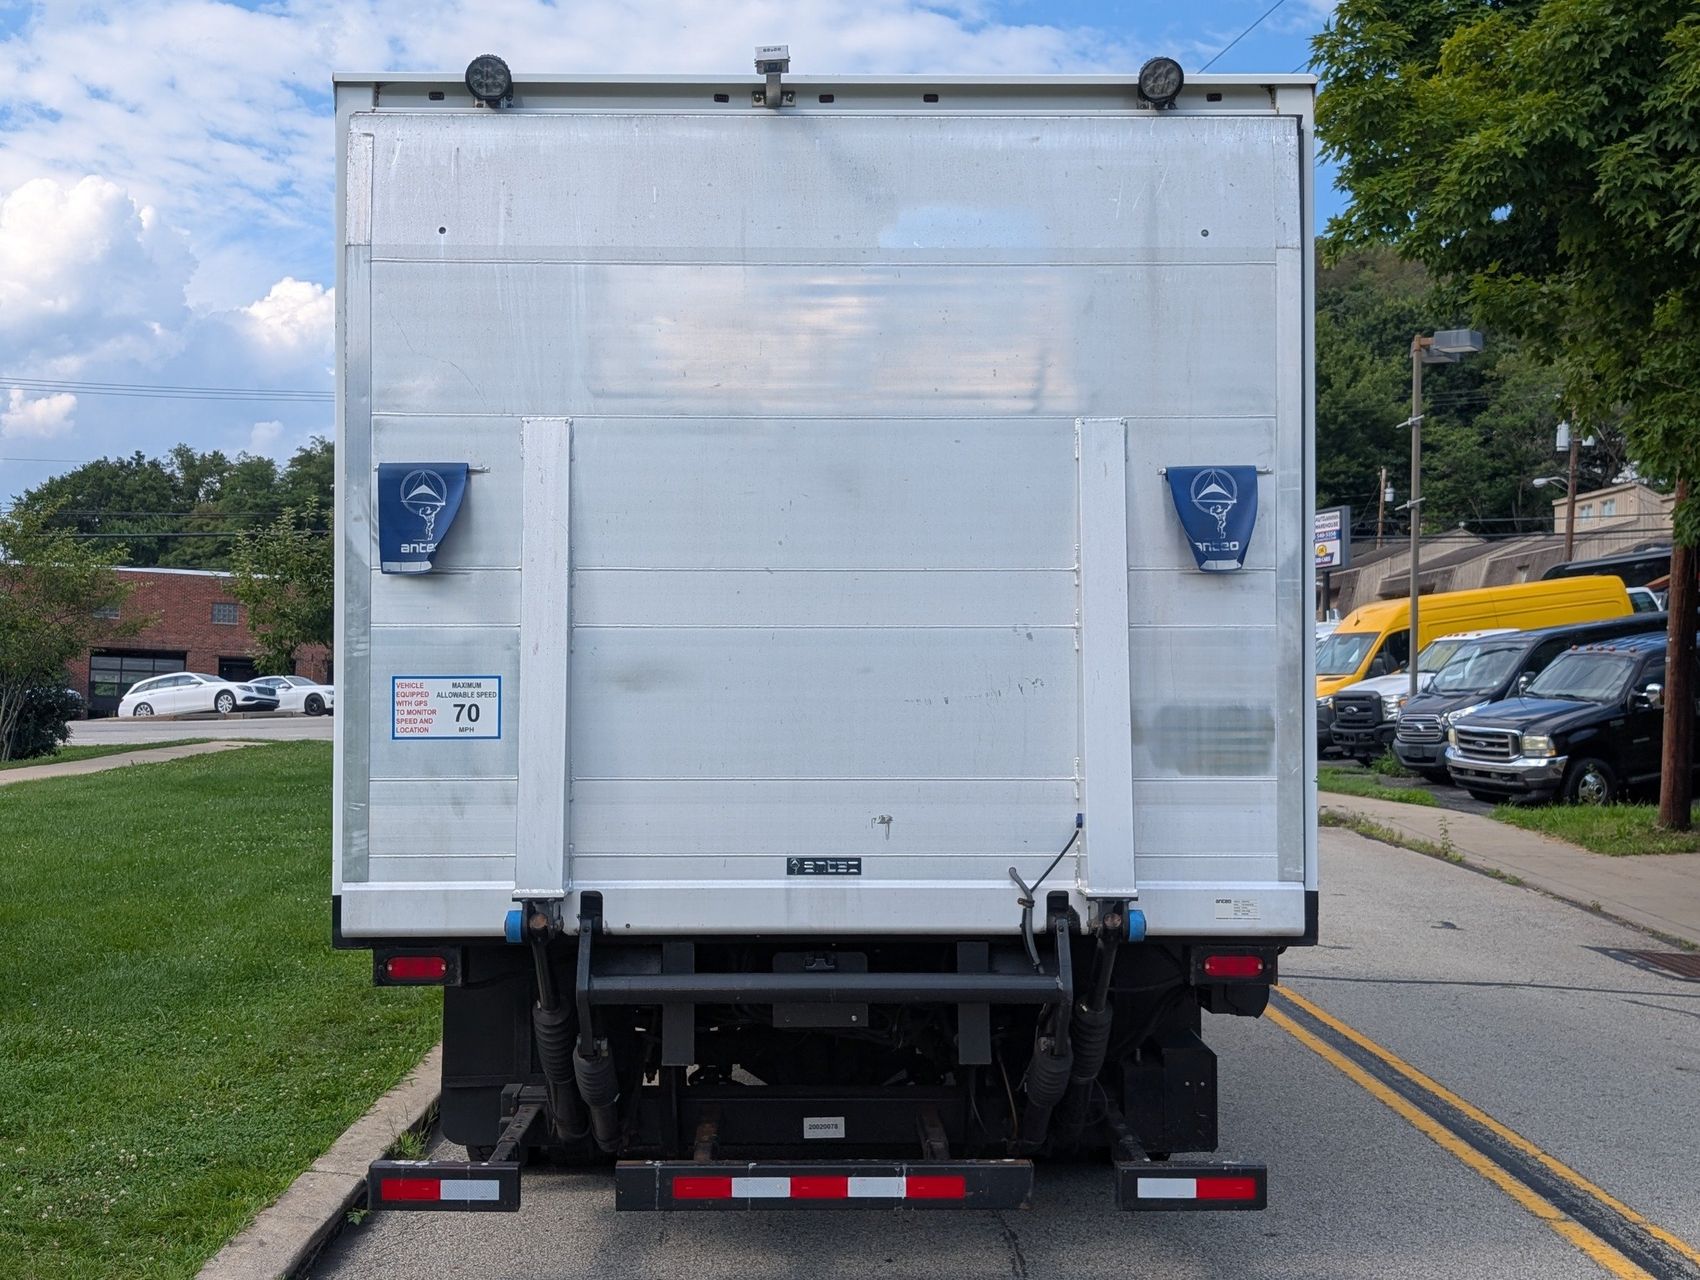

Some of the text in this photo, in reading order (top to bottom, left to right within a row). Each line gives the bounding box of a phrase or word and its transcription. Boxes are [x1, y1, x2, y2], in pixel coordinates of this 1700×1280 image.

[436, 691, 497, 699] ALLOWABLE SPEED
[453, 703, 480, 722] 70
